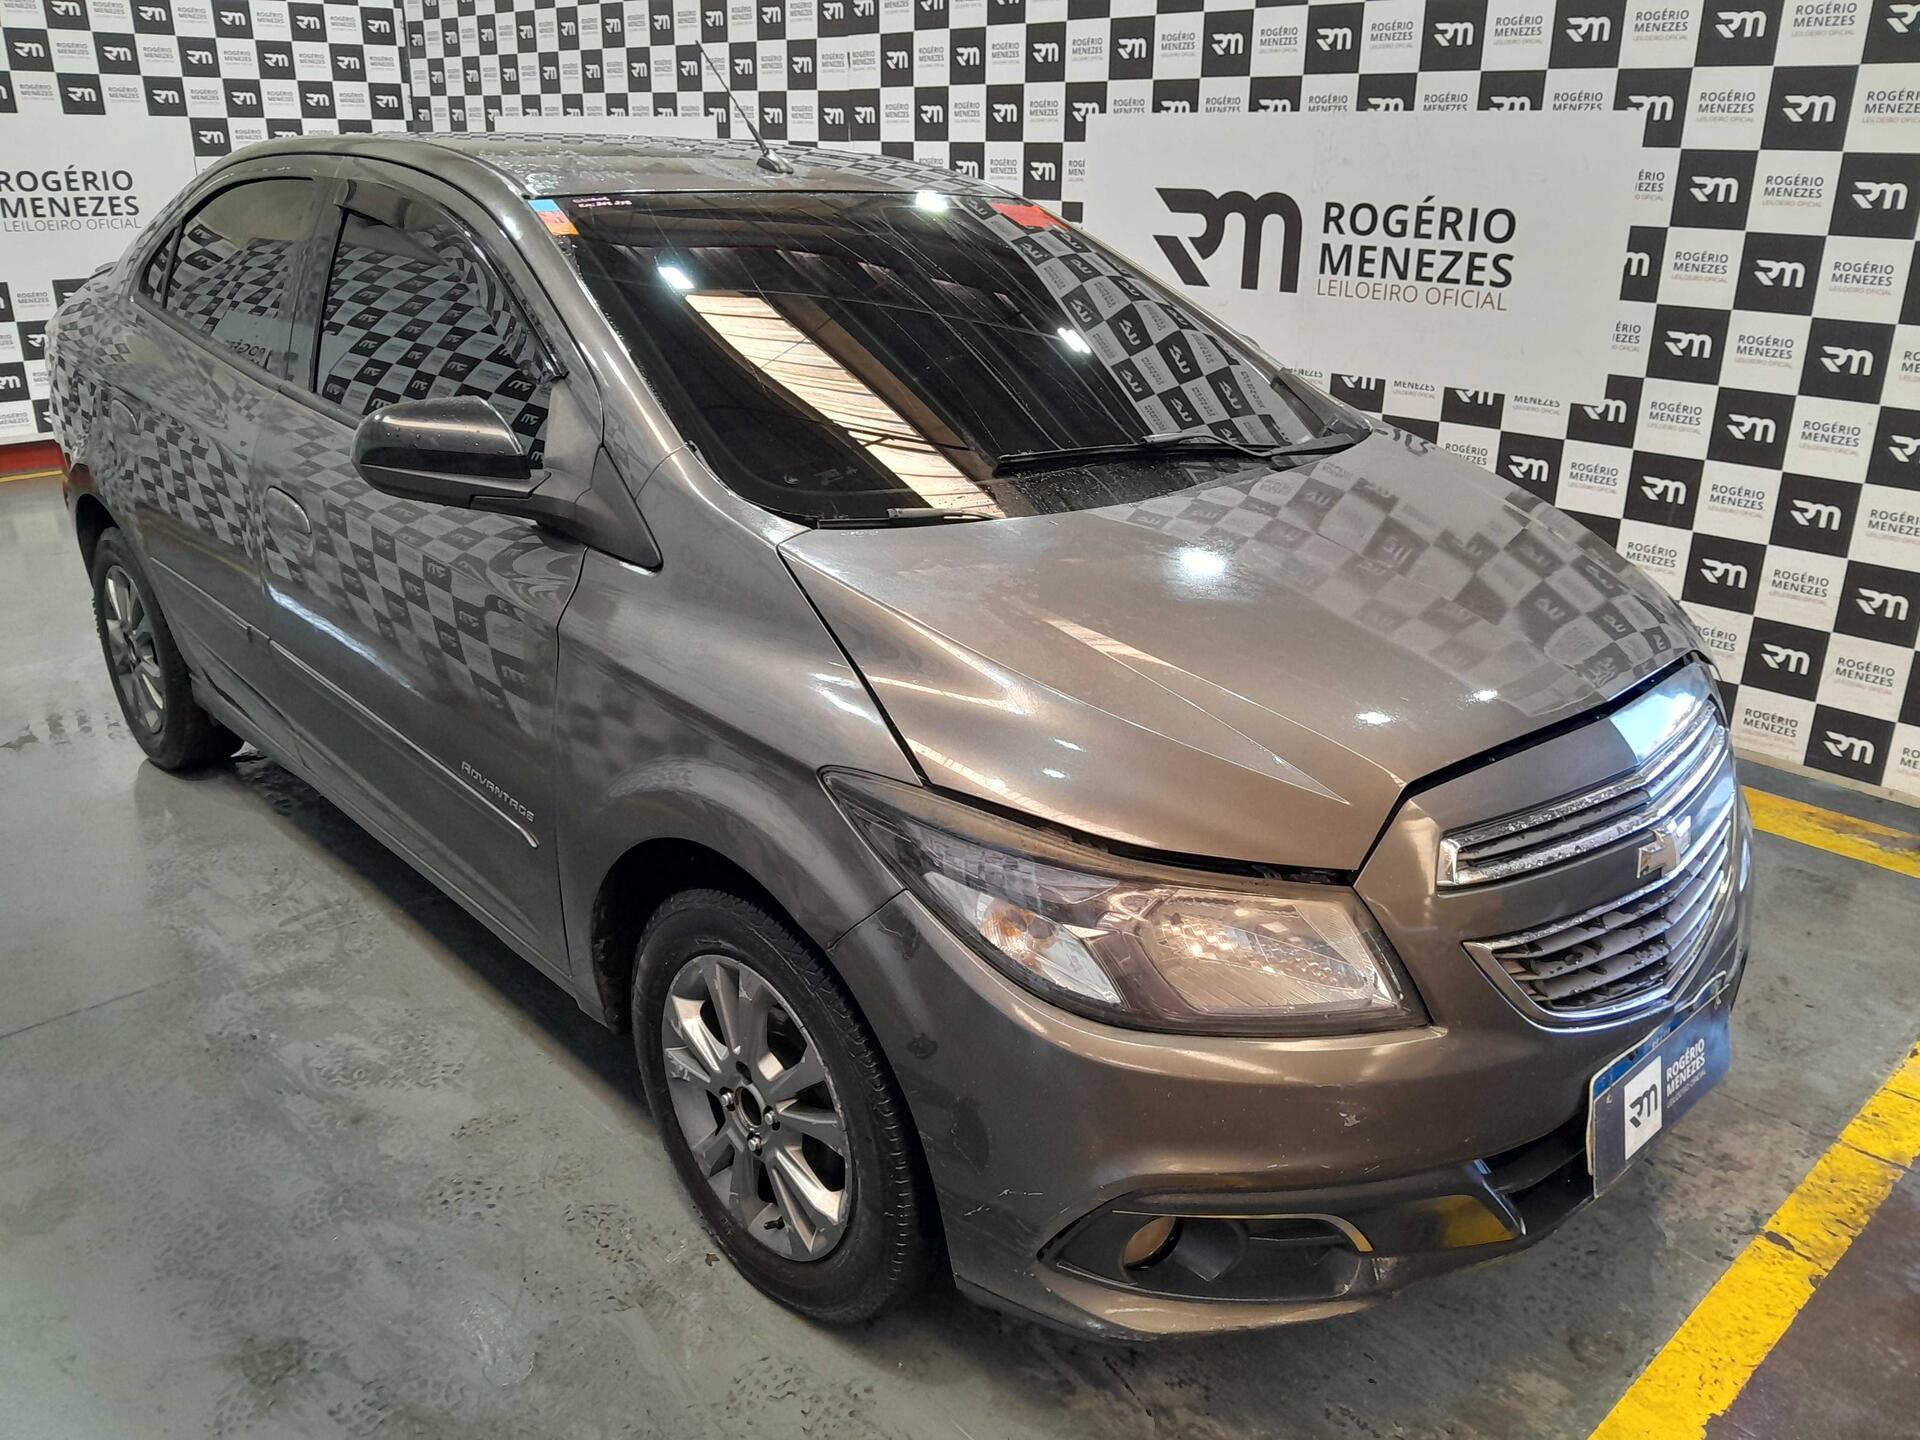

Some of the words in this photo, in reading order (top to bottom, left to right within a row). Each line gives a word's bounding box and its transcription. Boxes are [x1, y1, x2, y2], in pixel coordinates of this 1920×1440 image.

[1635, 8, 1689, 21] ROGÉRIO
[1795, 2, 1857, 15] ROGÉRIO
[1371, 20, 1414, 31] ROGÉRIO
[1496, 15, 1543, 26] ROGÉRIO
[1634, 22, 1688, 33] MENEZES
[1793, 16, 1855, 27] MENEZES
[1161, 32, 1195, 42] ROGÉRIO
[1260, 26, 1298, 37] ROGÉRIO
[1370, 32, 1413, 41] MENEZES
[1495, 27, 1542, 37] MENEZES
[1161, 42, 1195, 51] MENEZES
[1260, 37, 1298, 46] MENEZES
[1308, 94, 1348, 105] ROGÉRIO
[1424, 92, 1468, 103] ROGÉRIO
[1554, 90, 1603, 102] ROGÉRIO
[1700, 89, 1756, 102] ROGÉRIO
[1867, 89, 1920, 101] ROGÉRI
[1698, 104, 1754, 113] MENEZES
[1864, 103, 1920, 114] MENEZE
[0, 164, 133, 191] ROGÉRIO
[1638, 169, 1665, 181] ÉRIO
[1765, 174, 1824, 187] ROGÉRIO
[1638, 182, 1664, 192] EZES
[1763, 187, 1822, 198] MENEZES
[0, 196, 139, 218] MENEZES
[4, 221, 81, 232] LEILOEIRO
[86, 217, 142, 231] OFICIAL
[1322, 196, 1516, 244] ROGÉRIO
[1674, 251, 1729, 264] ROGÉRIO
[1319, 243, 1514, 288] MENEZES
[1673, 262, 1728, 275] MENEZES
[1833, 261, 1894, 275] ROGÉRIO
[1831, 273, 1892, 287] MENEZES
[1317, 279, 1415, 303] LEILOEIRO
[1424, 287, 1508, 311] OFICIAL
[1615, 320, 1641, 334] ÉRIO
[1738, 335, 1794, 349] ROGÉRIO
[1736, 345, 1792, 359] MENEZES
[1650, 401, 1702, 416] ROGÉRIO
[1649, 411, 1701, 425] MENEZES
[1803, 420, 1861, 436] ROGÉRIO
[1800, 432, 1859, 447] MENEZES
[1445, 442, 1488, 456] ROGÉRIO
[1466, 455, 1488, 466] EZES
[1570, 462, 1618, 476] ROGÉRIO
[1569, 472, 1618, 486] MENEZES
[1711, 483, 1765, 500] ROGÉRIO
[1710, 494, 1764, 511] MENEZES
[1870, 509, 1920, 525] ROGÉRI
[1867, 520, 1920, 536] MENEZE
[1627, 542, 1677, 558] ROGÉRIO
[1626, 551, 1676, 568] MENEZES
[1773, 569, 1829, 587] ROGÉRIO
[1771, 579, 1828, 597] MENEZES
[1696, 625, 1737, 641] OGÉRIO
[1710, 639, 1735, 651] EZES
[1837, 657, 1895, 677] ROGÉRIO
[1835, 667, 1894, 688] MENEZES
[1745, 708, 1798, 728] ROGÉRIO
[1743, 717, 1796, 737] MENEZES
[461, 761, 535, 822] ADVANTAGE
[1667, 1038, 1705, 1081] ROGÉRIO
[1667, 1052, 1705, 1097] MENEZES
